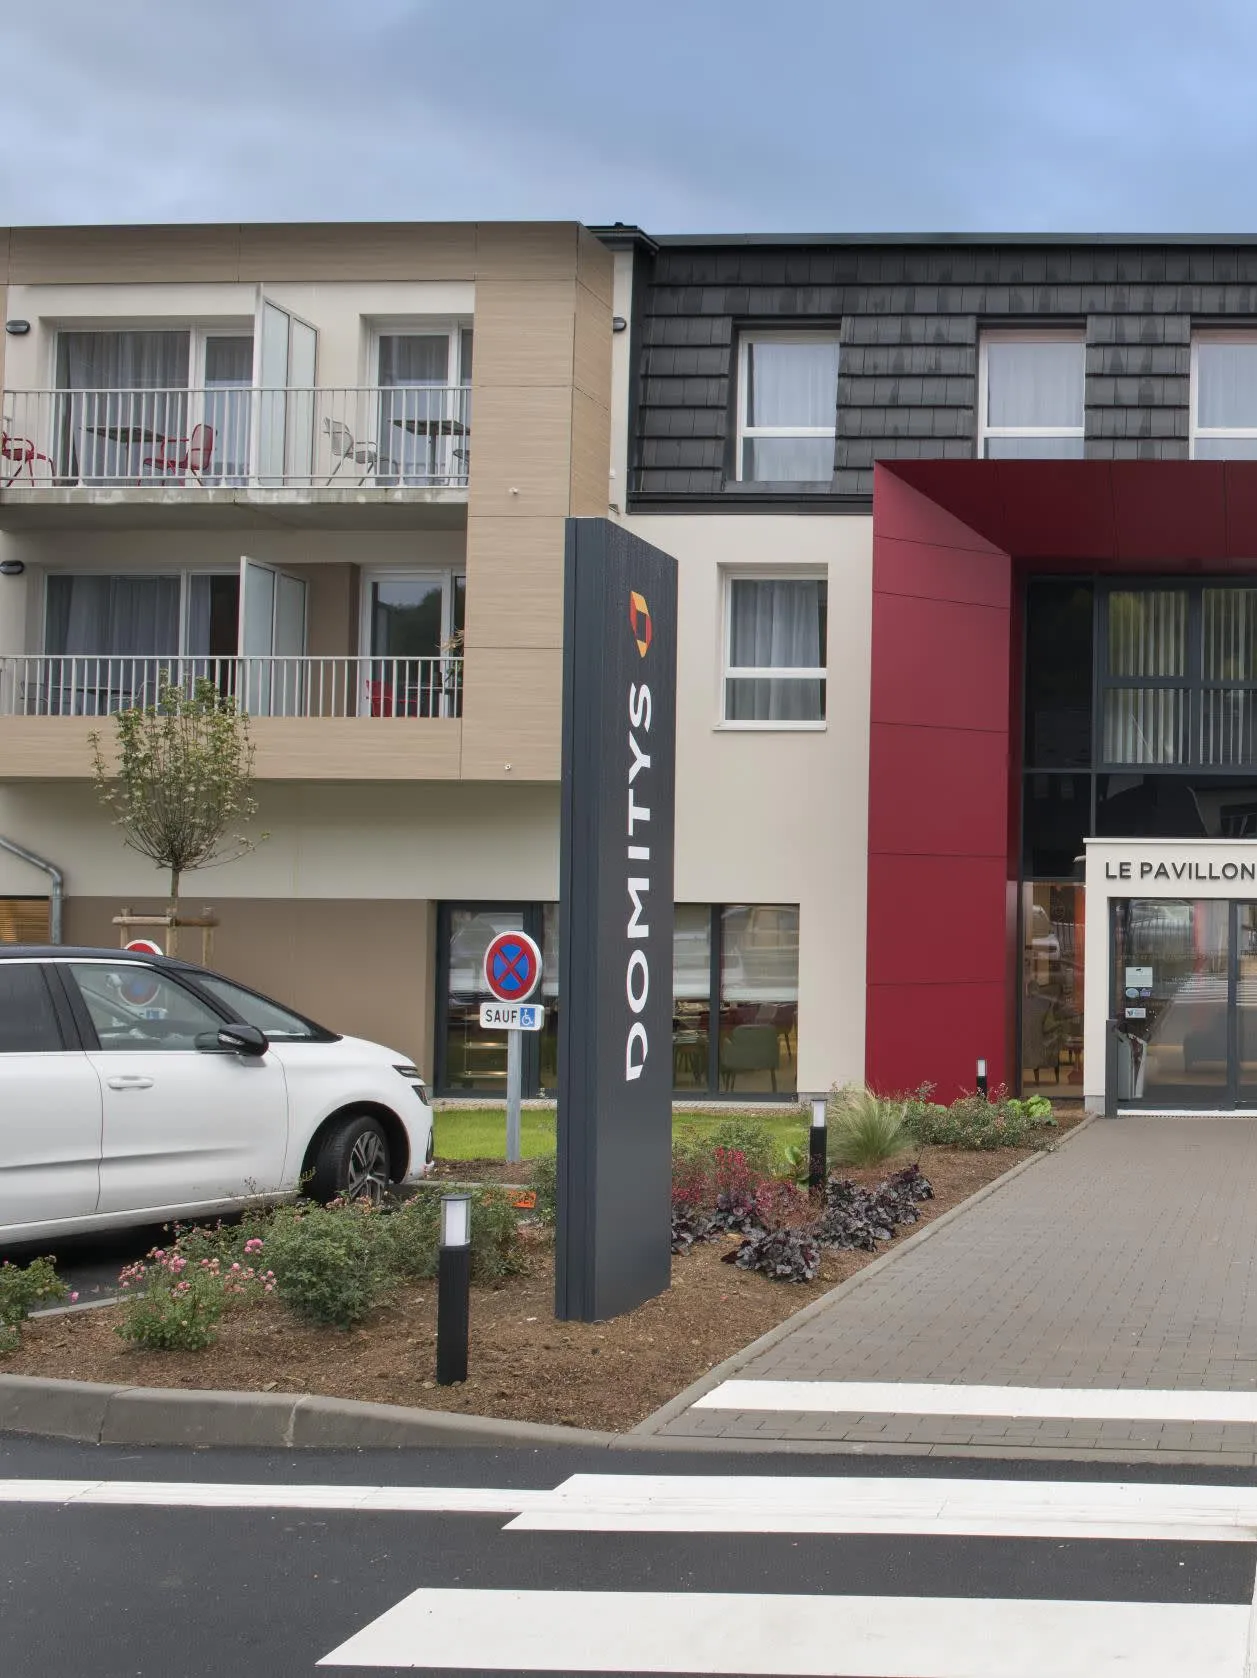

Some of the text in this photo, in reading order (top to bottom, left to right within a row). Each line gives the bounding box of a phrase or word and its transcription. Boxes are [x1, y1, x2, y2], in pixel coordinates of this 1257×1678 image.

[1105, 862, 1132, 880] LE
[1140, 862, 1255, 881] PAVILLON
[625, 682, 653, 1082] DOMITYS
[485, 1009, 517, 1023] SAUF
